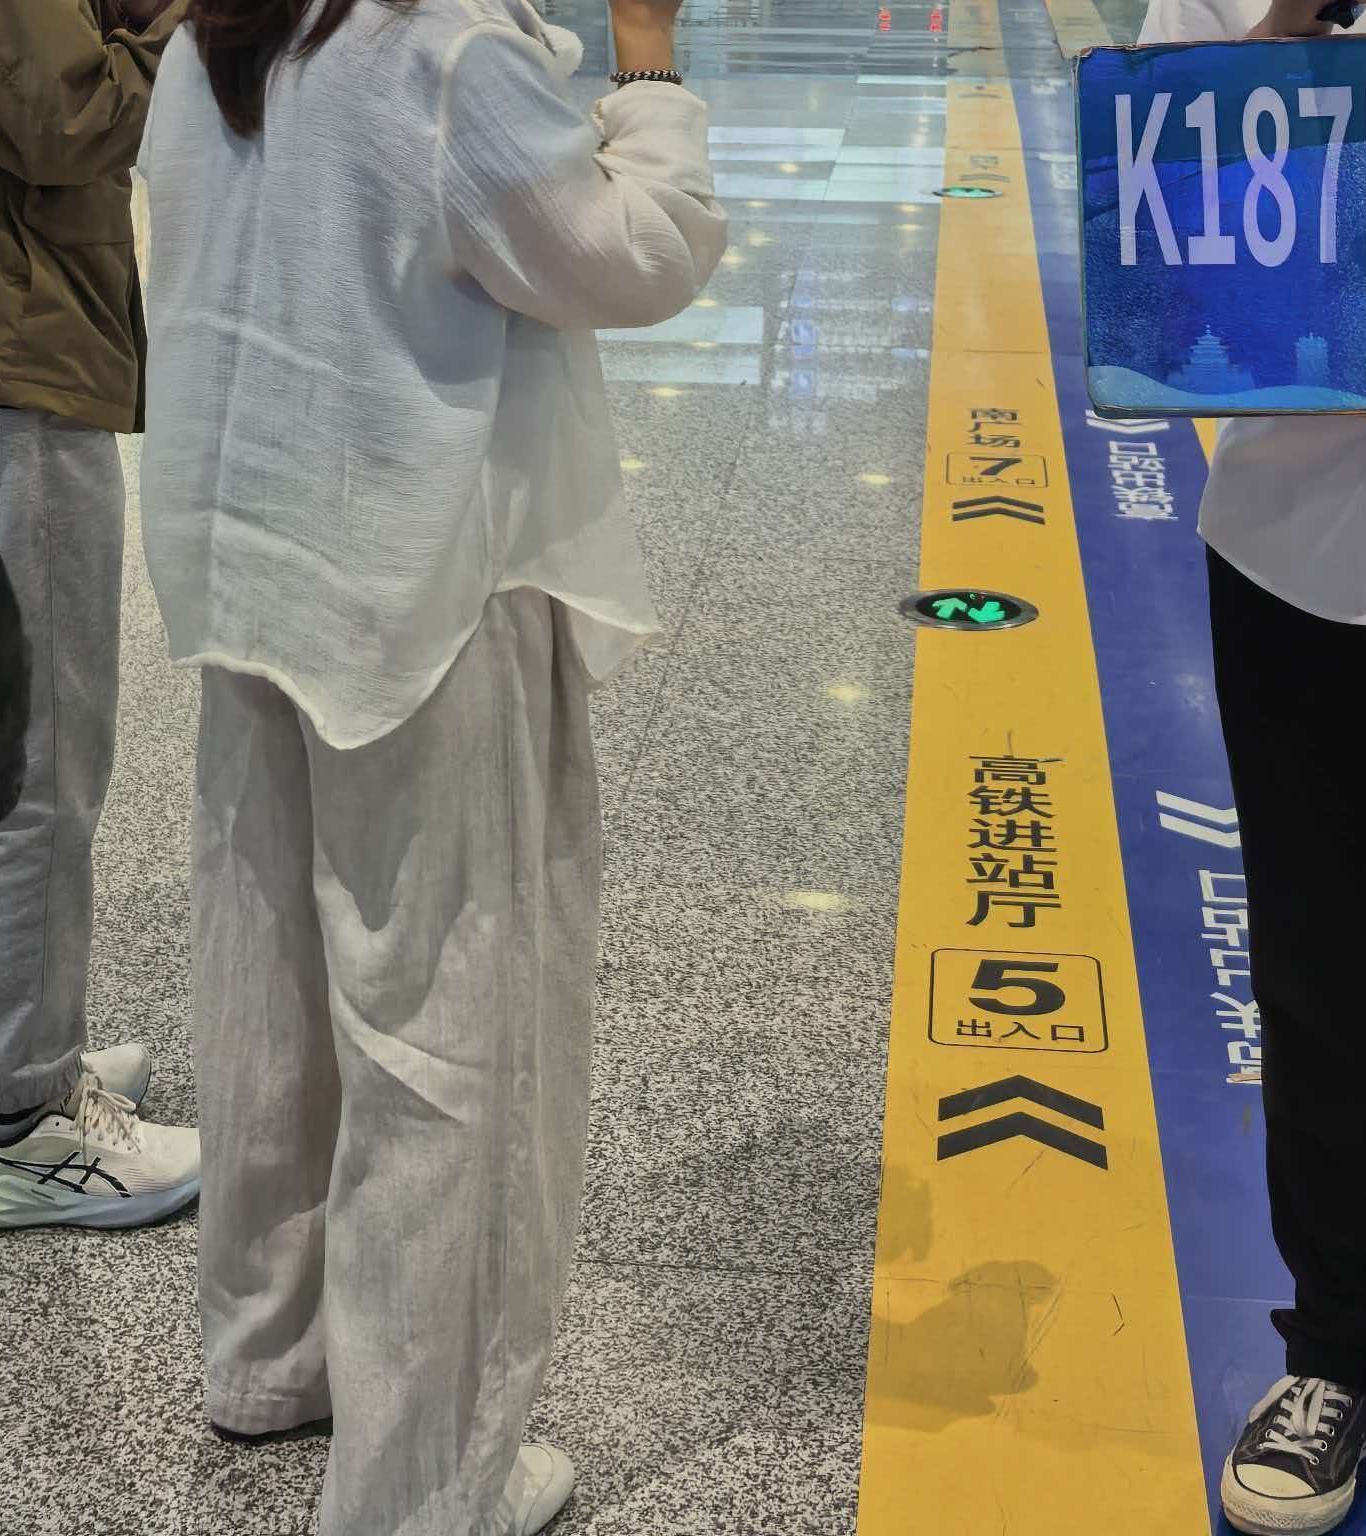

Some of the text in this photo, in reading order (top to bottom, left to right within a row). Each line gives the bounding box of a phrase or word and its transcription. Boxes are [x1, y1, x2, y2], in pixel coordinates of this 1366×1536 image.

[967, 408, 1021, 448] 南广场
[969, 456, 1023, 476] 7
[965, 754, 1062, 928] 高铁进站厅
[969, 959, 1066, 1016] 5
[956, 1018, 1085, 1043] 出入口
